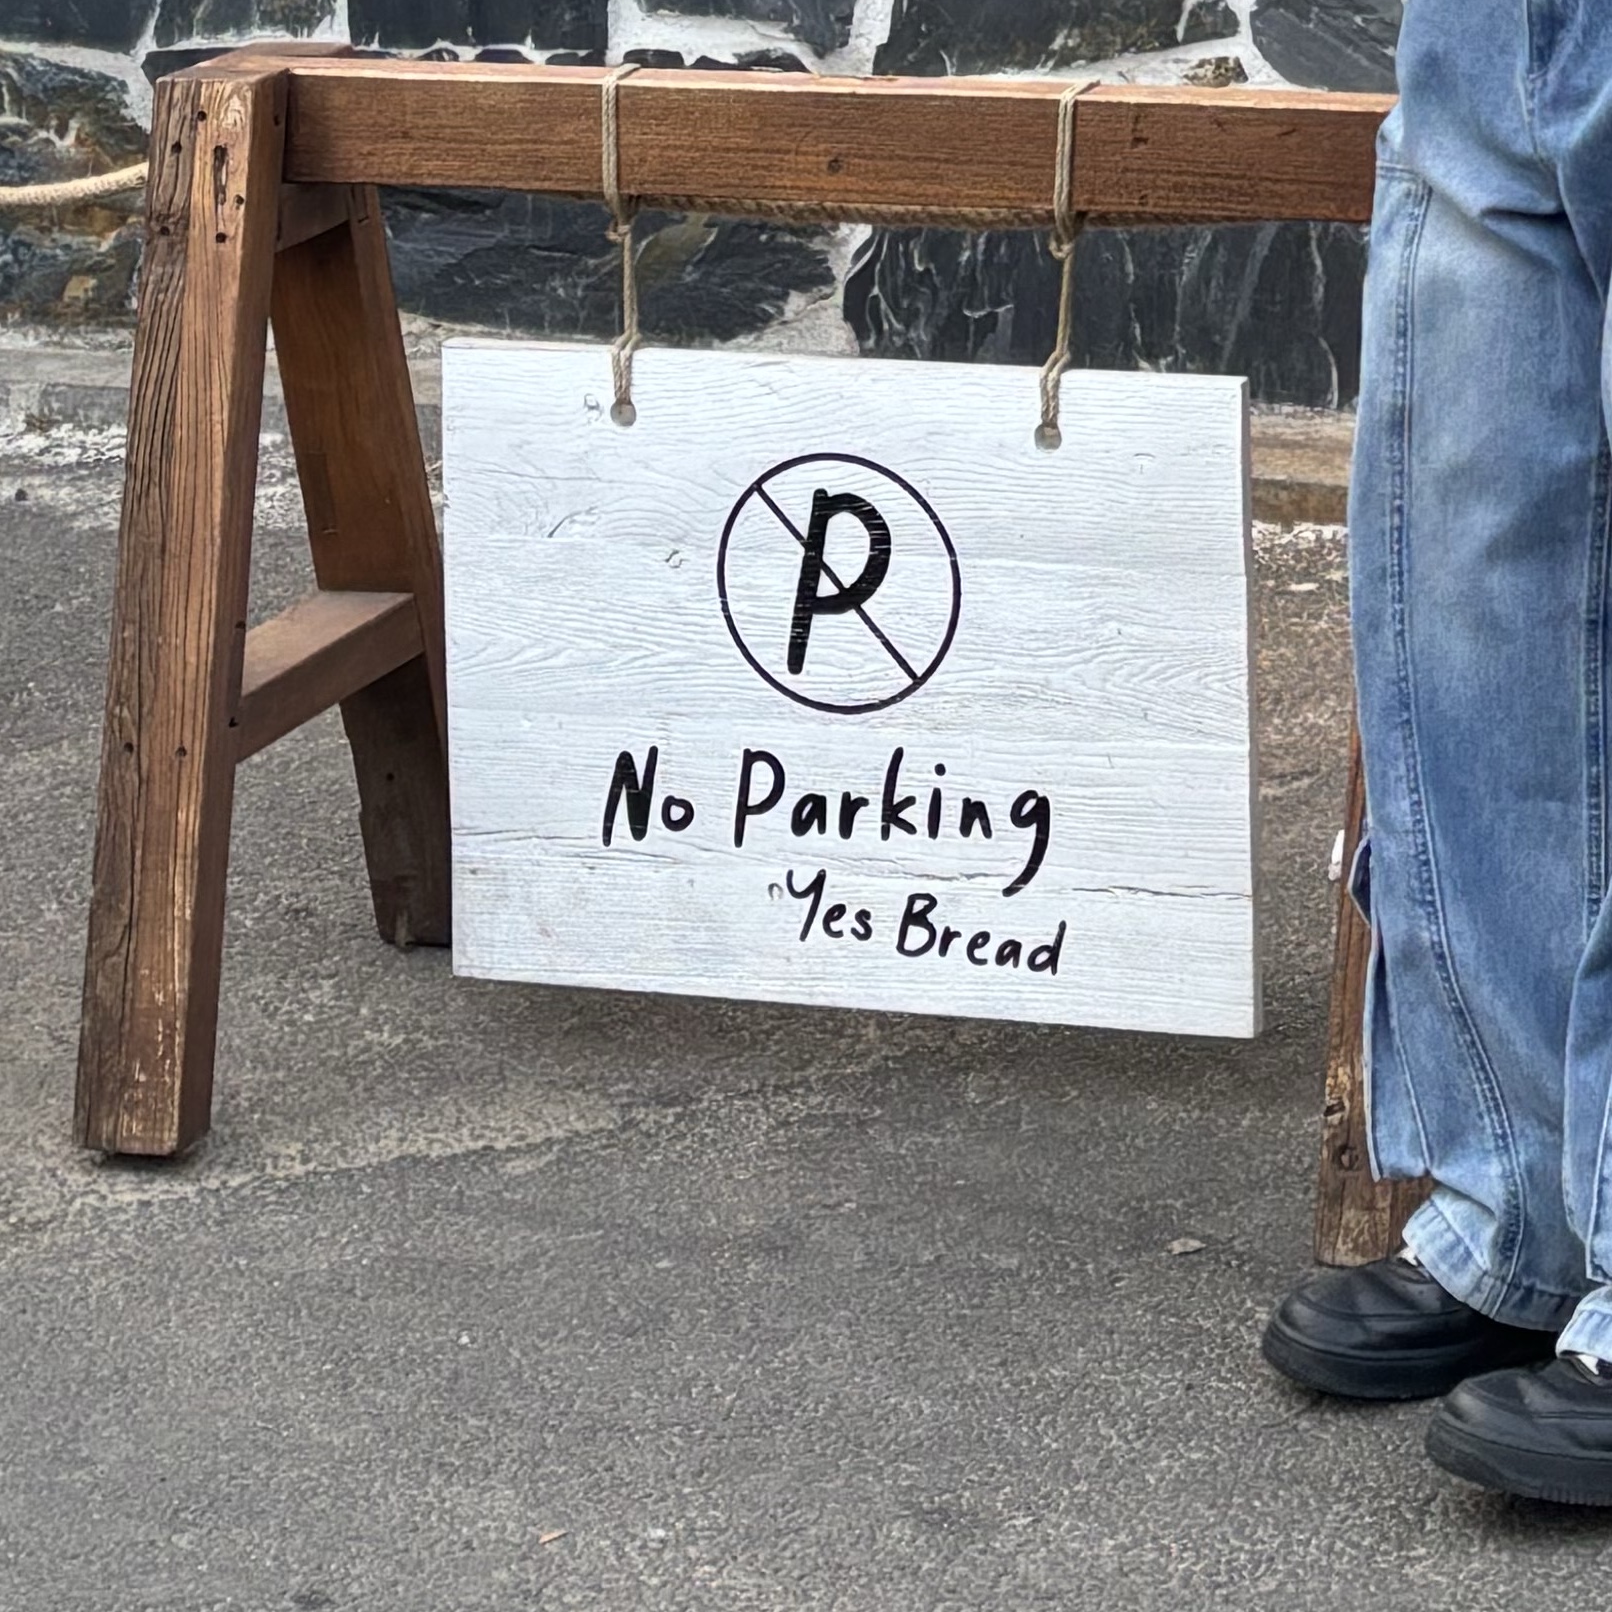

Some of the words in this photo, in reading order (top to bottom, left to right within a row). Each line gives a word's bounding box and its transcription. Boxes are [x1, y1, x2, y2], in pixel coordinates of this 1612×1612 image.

[784, 488, 894, 675] P
[602, 745, 695, 847] No
[734, 747, 1051, 901] Parking
[786, 869, 873, 942] Yes
[896, 887, 1067, 976] Bread
